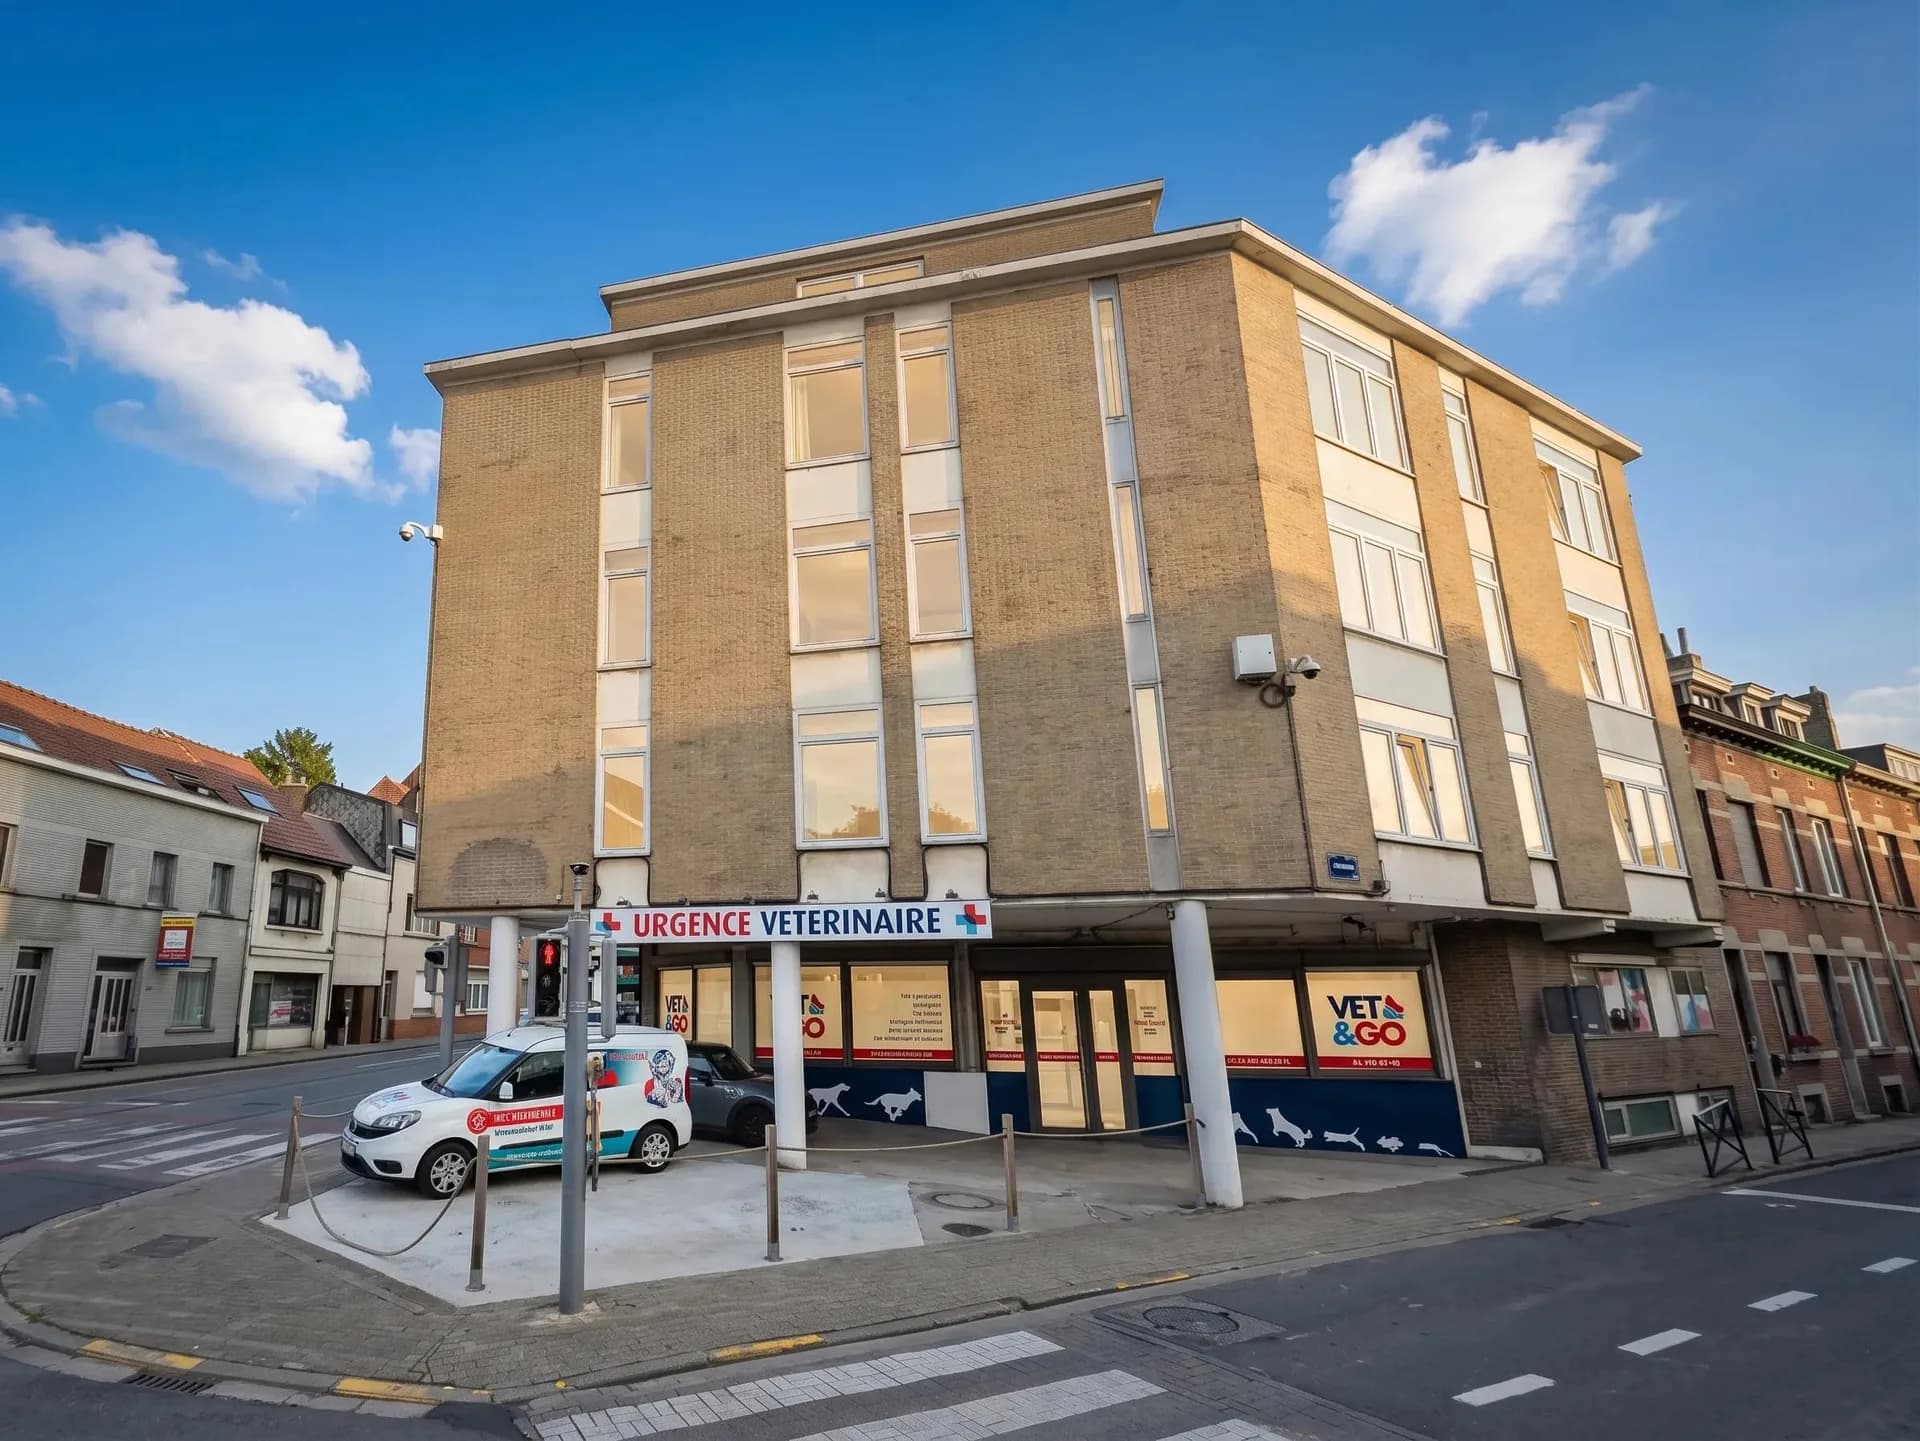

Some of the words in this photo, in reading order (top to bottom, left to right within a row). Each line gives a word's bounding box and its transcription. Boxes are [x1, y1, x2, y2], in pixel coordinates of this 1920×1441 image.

[633, 911, 751, 938] URGENCE
[760, 907, 942, 936] VETERINAIRE
[665, 995, 683, 1013] VET
[1326, 995, 1383, 1019] VET
[665, 1014, 688, 1033] &GO
[1333, 1020, 1406, 1046] &GO
